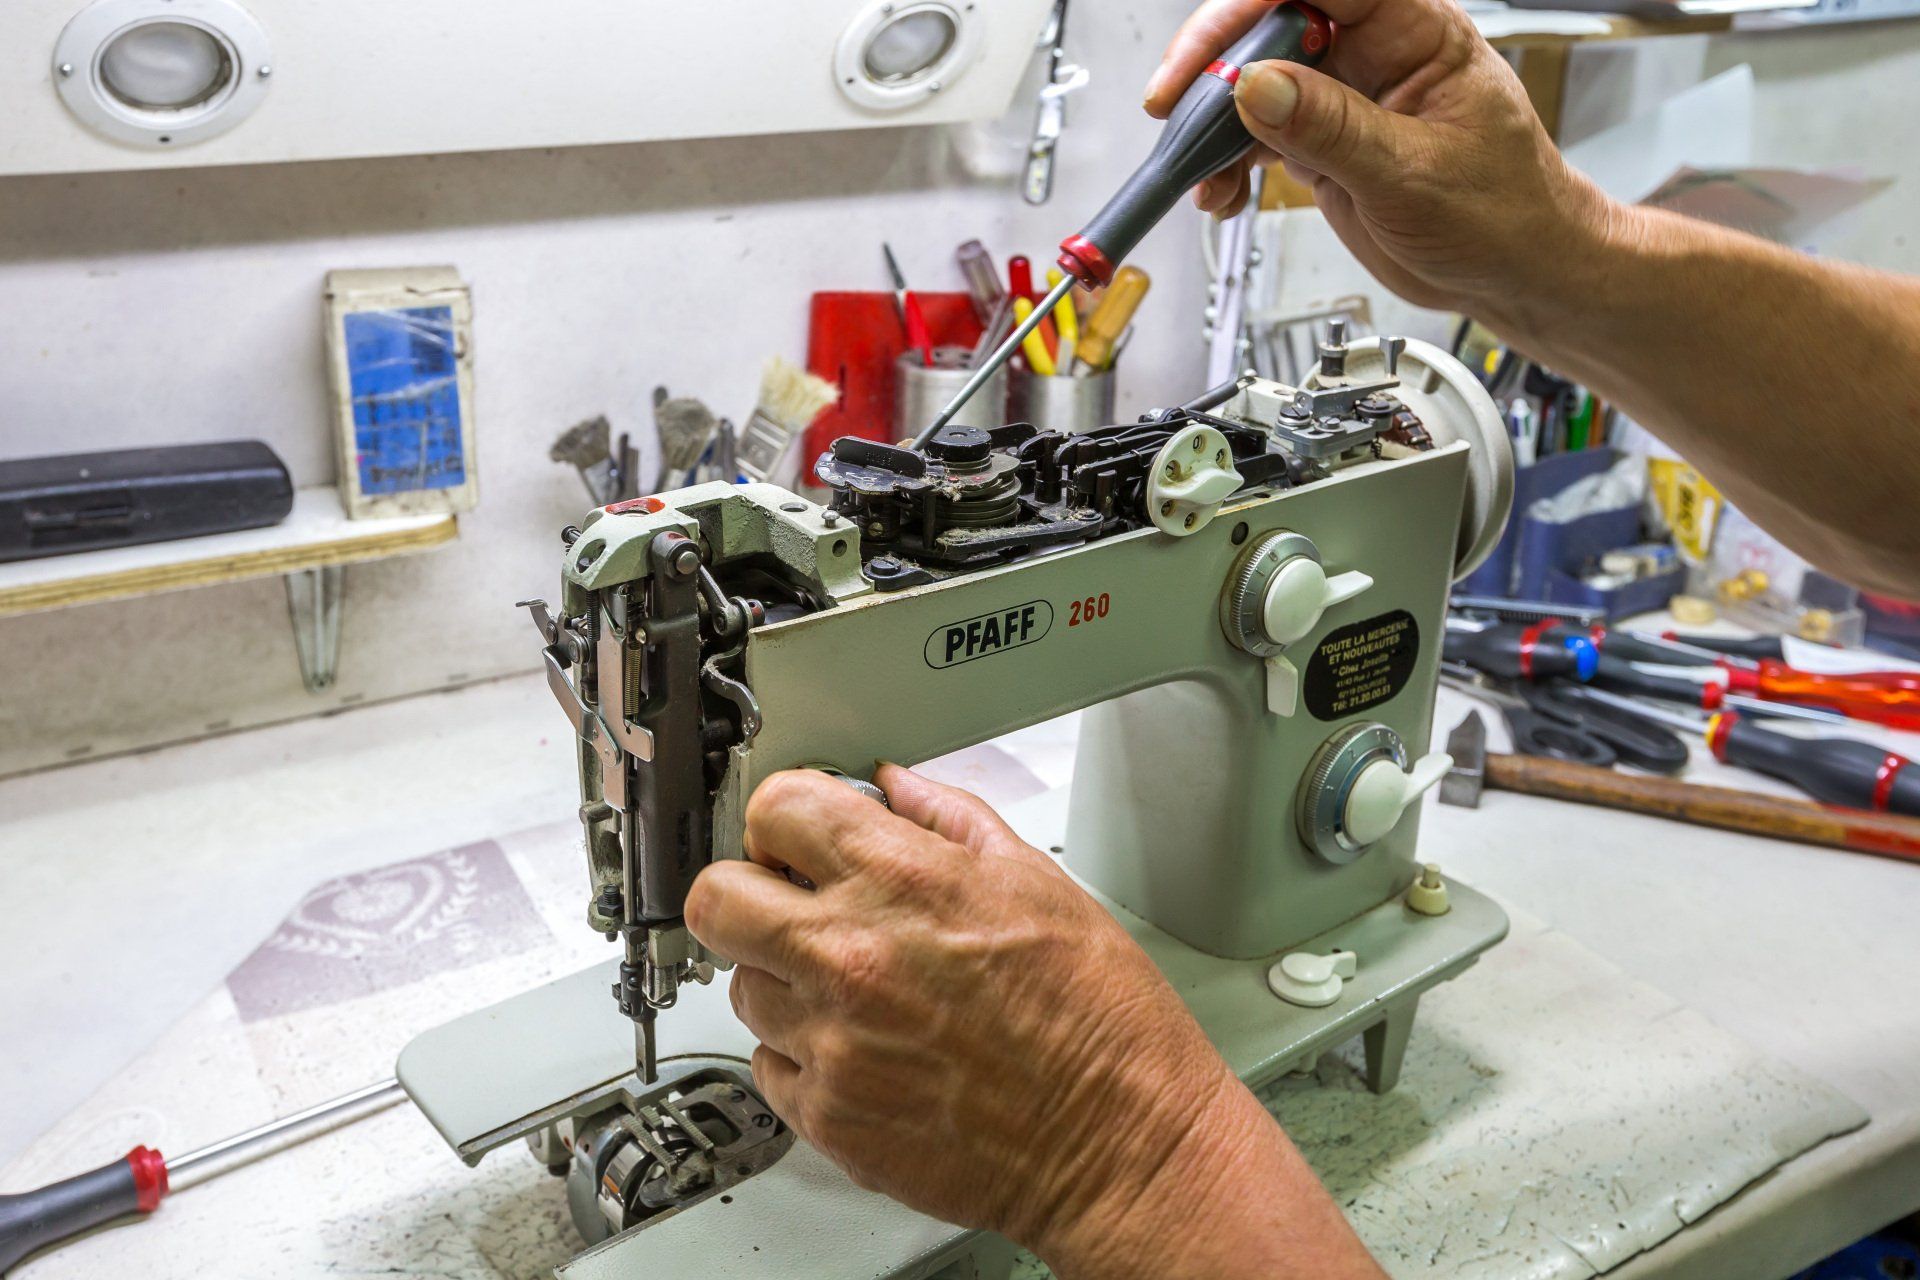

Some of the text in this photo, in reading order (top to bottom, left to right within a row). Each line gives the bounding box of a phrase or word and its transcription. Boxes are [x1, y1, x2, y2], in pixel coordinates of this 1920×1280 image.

[945, 592, 1110, 662] PFAFF 260
[1321, 637, 1352, 656] TOUTE
[1354, 634, 1365, 646] LA
[1329, 634, 1400, 665] ET NOUVEAUTES
